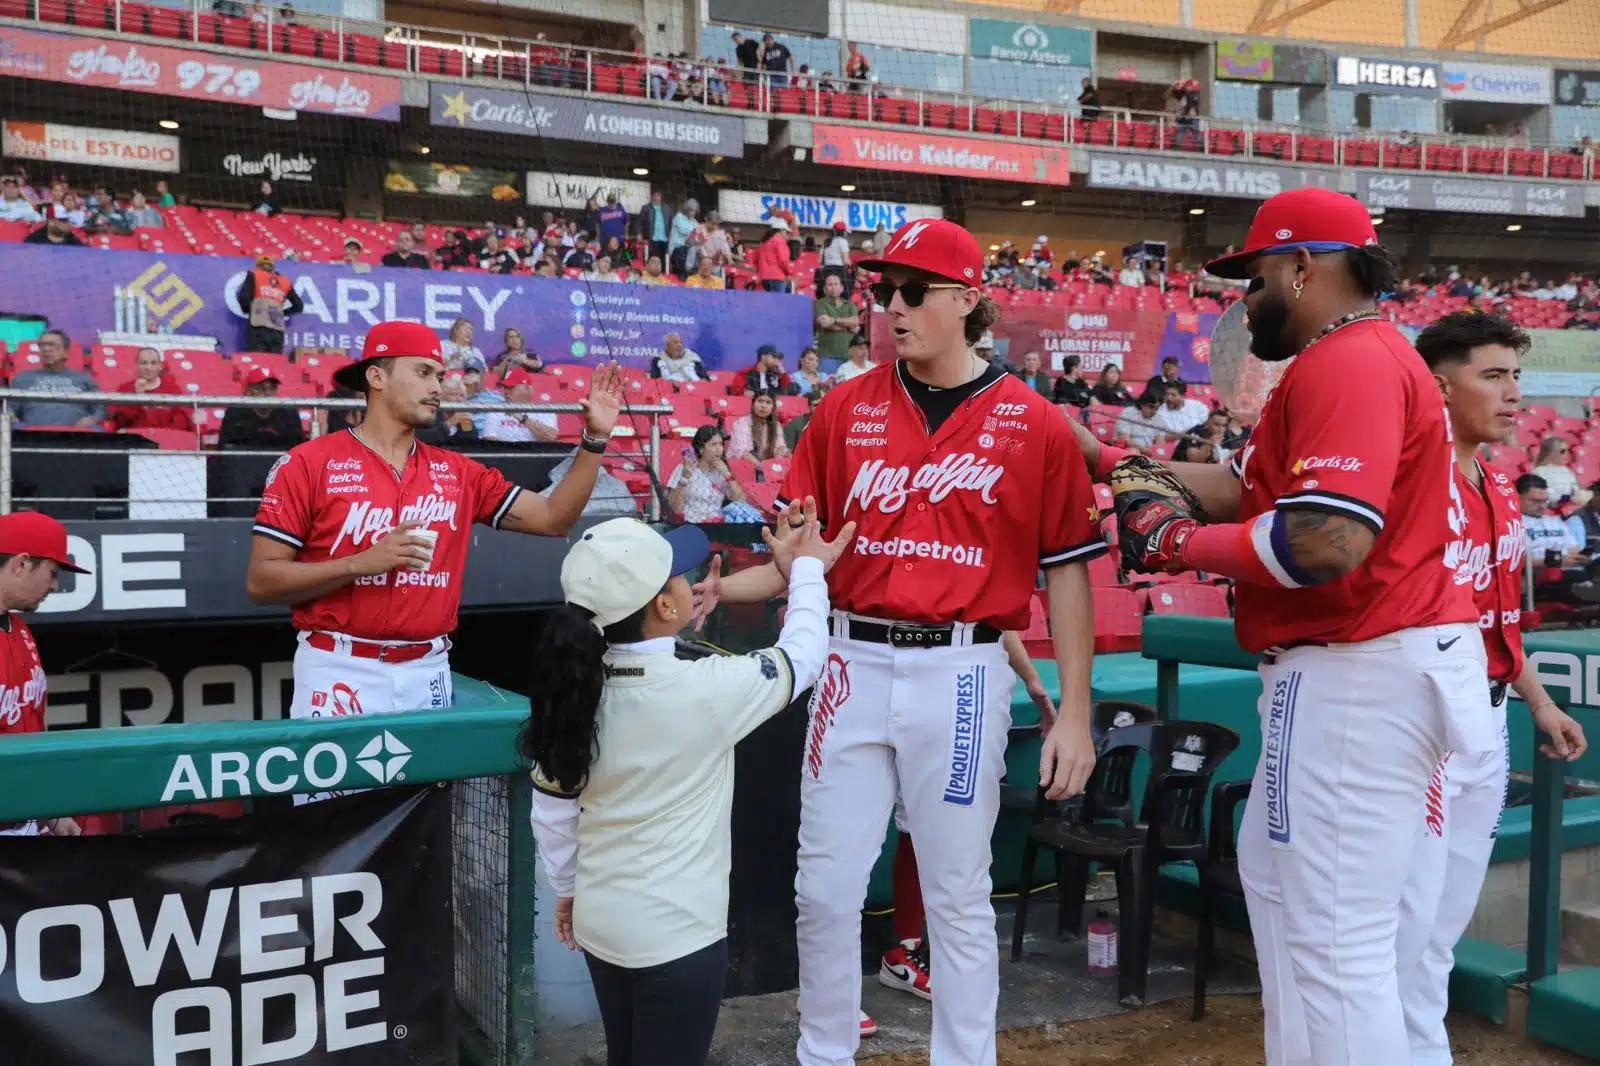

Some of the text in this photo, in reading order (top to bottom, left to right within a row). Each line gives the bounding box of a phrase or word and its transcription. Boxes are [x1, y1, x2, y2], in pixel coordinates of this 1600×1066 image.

[176, 60, 261, 97] 97.9
[1360, 61, 1437, 88] HERSA
[1471, 74, 1541, 93] Chevron
[583, 114, 597, 133] A
[599, 114, 652, 137] COMER
[654, 120, 676, 140] EN
[677, 122, 721, 144] SERIO
[51, 139, 79, 151] DEL
[86, 139, 176, 163] ESTADIO
[760, 194, 909, 231] SUNNY BUNS
[1044, 338, 1059, 351] LA
[1060, 339, 1090, 351] GRAN
[992, 402, 1029, 416] ms
[851, 420, 887, 434] telcel
[998, 420, 1028, 431] HERSA
[1302, 456, 1362, 473] Carl's Jr.
[328, 472, 364, 484] telcel
[160, 742, 347, 802] ARCO
[0, 872, 386, 1004] OWER
[152, 957, 388, 1066] ADE
